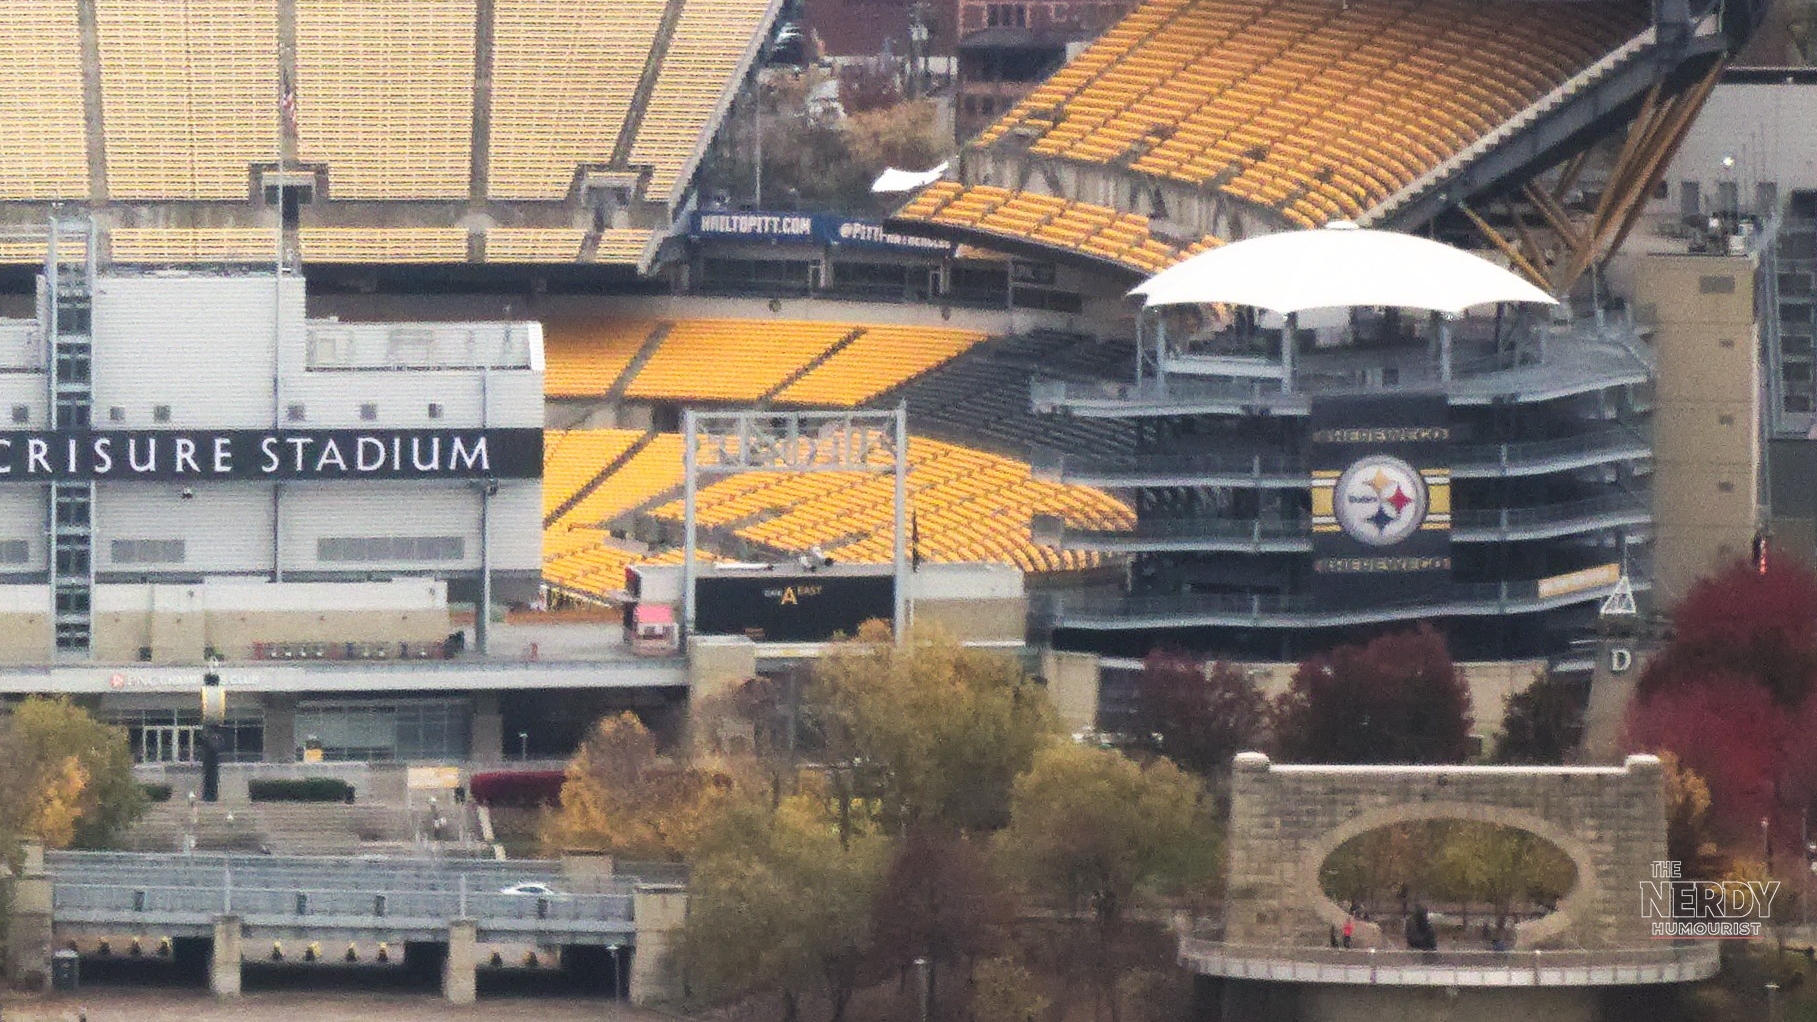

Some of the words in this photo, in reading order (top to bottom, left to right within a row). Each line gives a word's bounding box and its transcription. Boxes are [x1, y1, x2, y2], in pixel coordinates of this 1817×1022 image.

[260, 435, 492, 472] STADIUM
[781, 587, 797, 605] A
[798, 586, 821, 595] EAST
[1611, 648, 1632, 671] D
